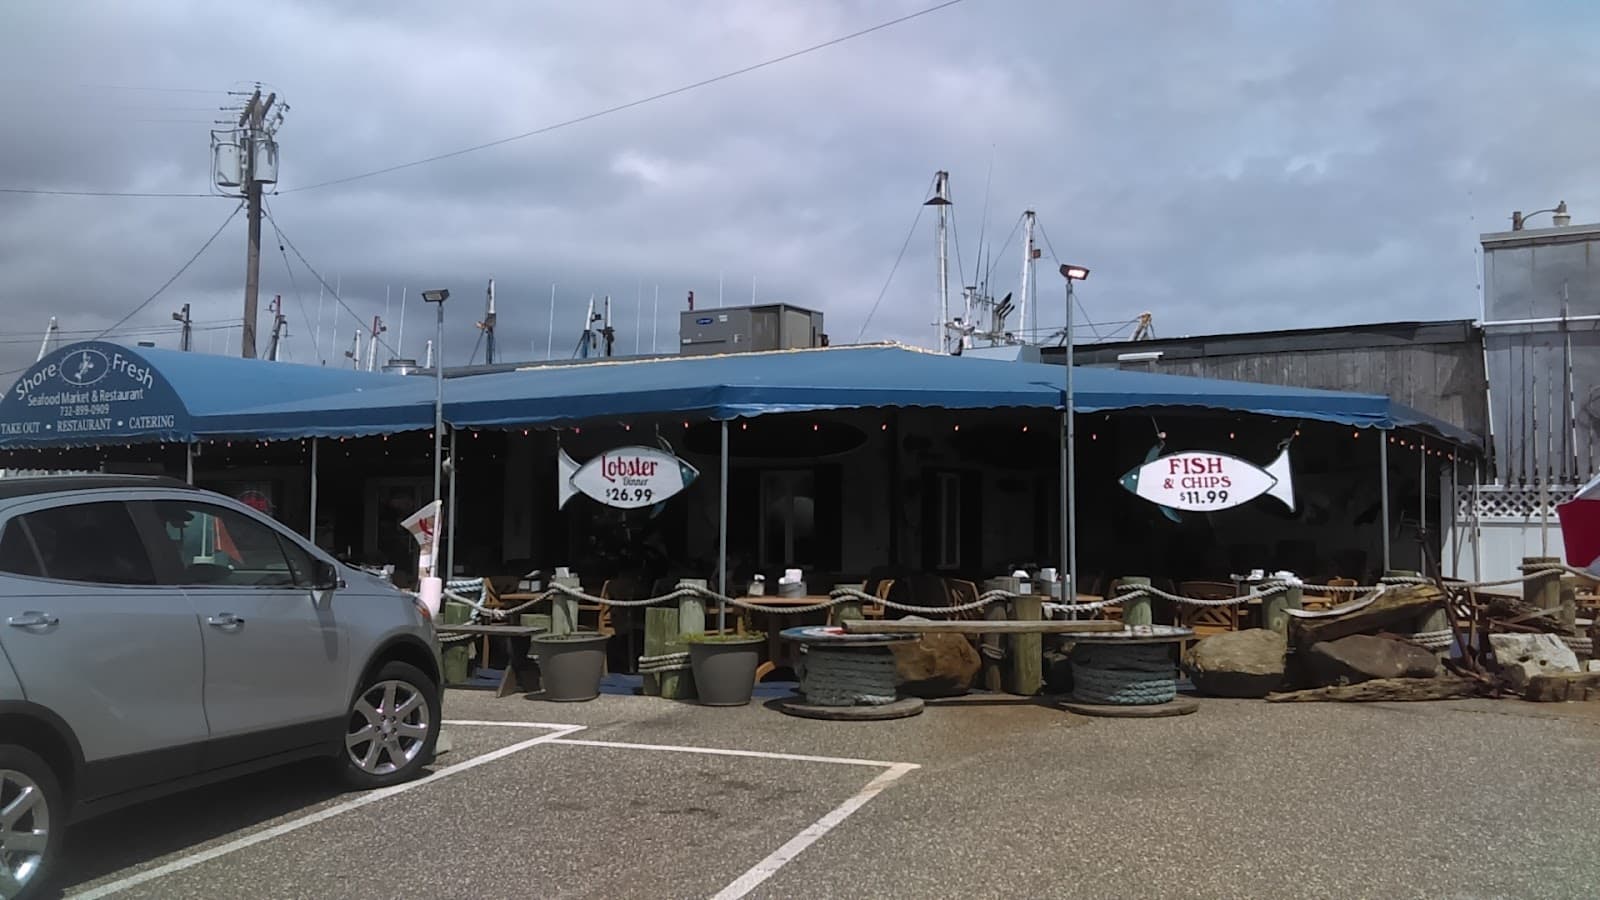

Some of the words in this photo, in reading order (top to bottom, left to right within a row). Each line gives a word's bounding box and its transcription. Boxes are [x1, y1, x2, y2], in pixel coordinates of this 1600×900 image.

[15, 363, 57, 401] Shore
[112, 352, 154, 389] Fresh
[27, 392, 61, 407] Seafood
[61, 390, 90, 403] Market
[92, 390, 98, 401] &
[99, 388, 144, 402] Restaurant
[1, 422, 22, 434] TAKE
[23, 421, 41, 433] OUT
[57, 418, 112, 432] RESTAURANT
[128, 415, 175, 429] CATERING
[602, 455, 659, 483] Lobster
[1168, 457, 1223, 475] FISH
[1163, 478, 1174, 489] &
[1181, 476, 1232, 488] CHIPS
[605, 487, 653, 501] $26.99
[1180, 490, 1228, 504] $11.99
